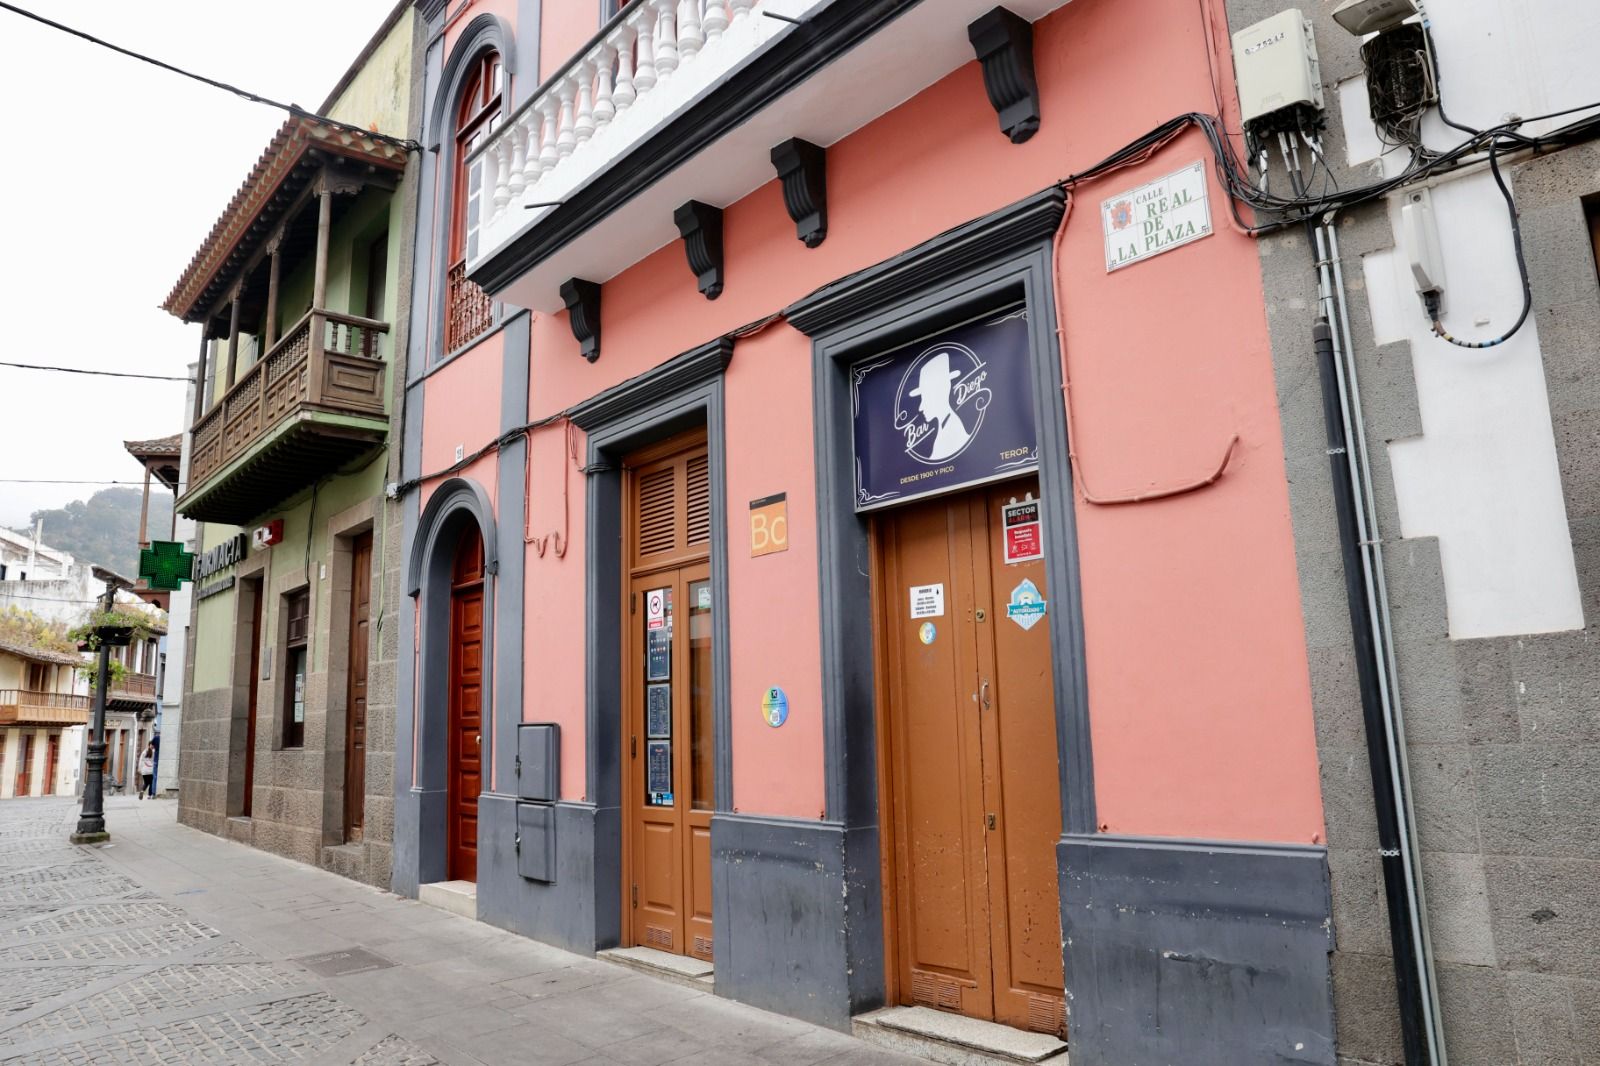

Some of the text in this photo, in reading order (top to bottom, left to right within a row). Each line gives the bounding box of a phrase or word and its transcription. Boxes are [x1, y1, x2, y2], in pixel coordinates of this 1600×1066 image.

[1135, 187, 1163, 205] CALLE
[1146, 188, 1192, 218] REAL
[1143, 215, 1164, 236] DE
[1118, 220, 1196, 261] LA PLAZA
[954, 370, 987, 405] Diego
[904, 423, 929, 447] Bar
[1000, 446, 1029, 460] TEROR
[900, 474, 919, 484] DESDE
[920, 471, 934, 480] 1900
[939, 465, 955, 473] PICO
[1007, 505, 1036, 518] SECTOR
